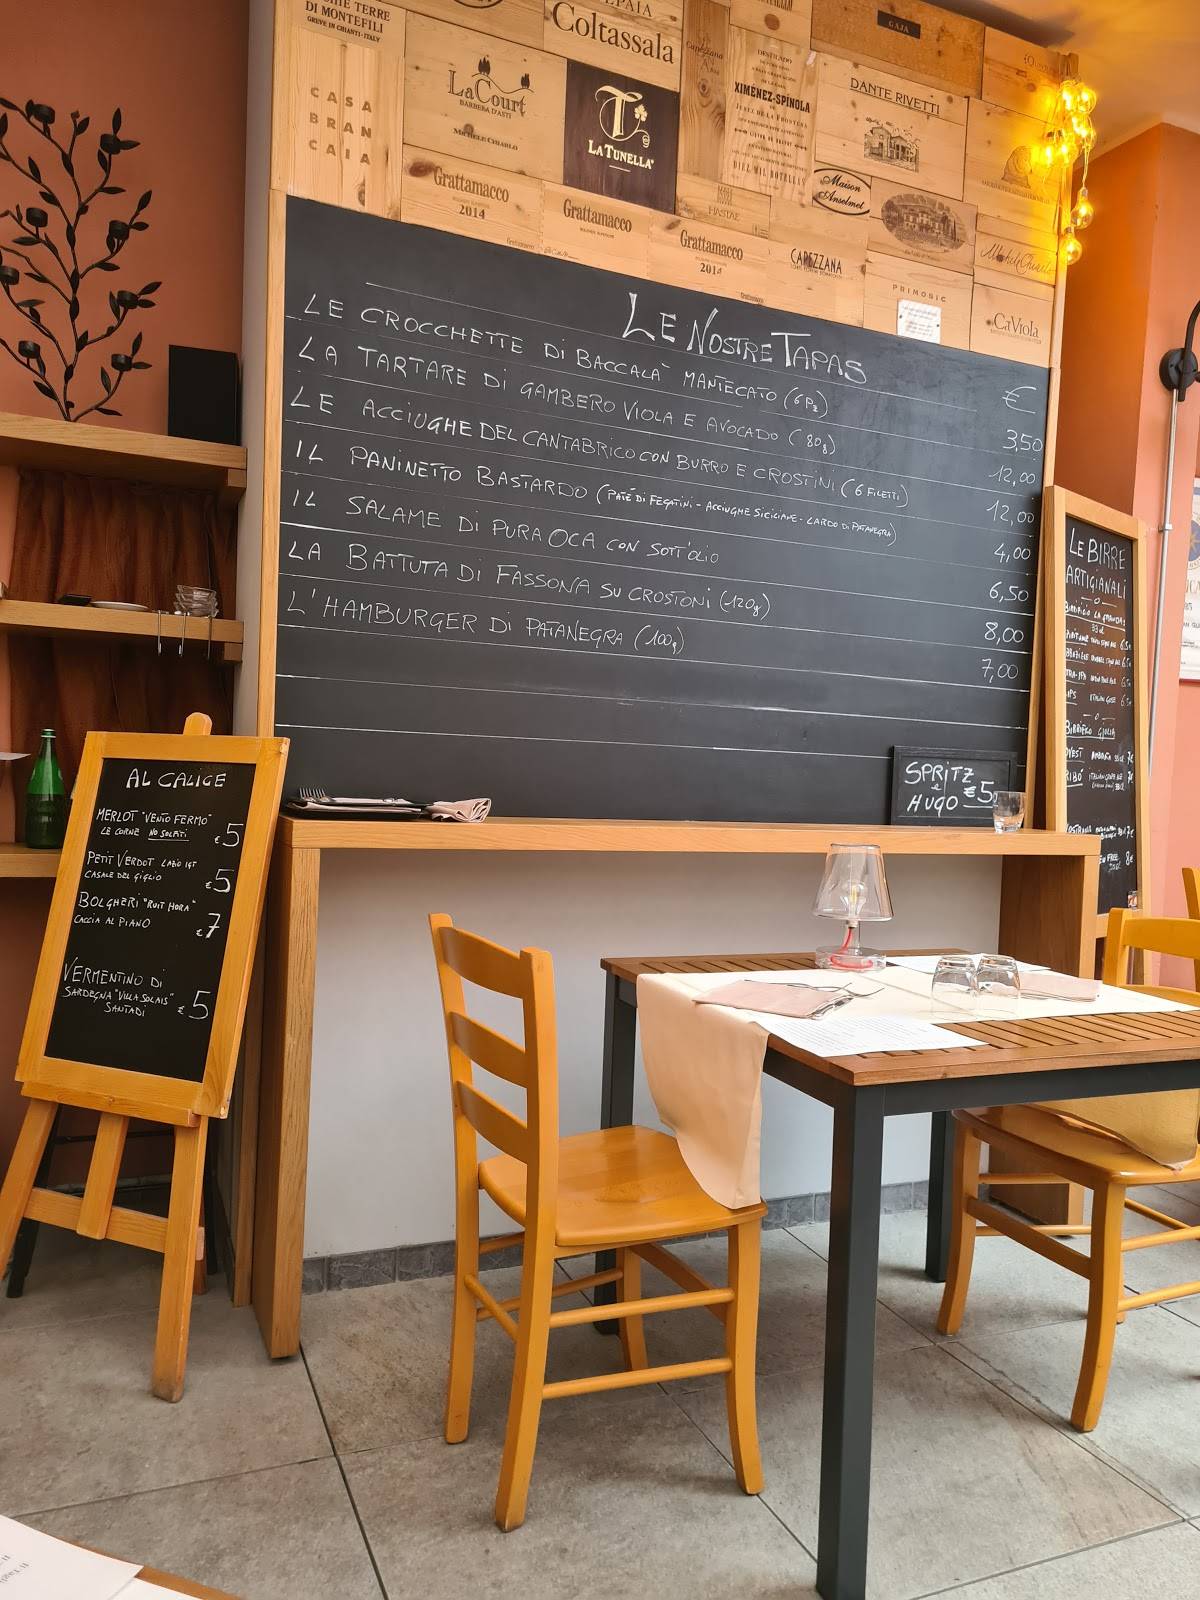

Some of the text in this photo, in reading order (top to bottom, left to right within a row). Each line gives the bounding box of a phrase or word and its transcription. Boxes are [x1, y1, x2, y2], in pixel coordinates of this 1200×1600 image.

[305, 0, 383, 33] DI MONTEFILI
[307, 15, 327, 27] GREVE
[355, 1, 391, 22] TERRE
[552, 1, 674, 64] Coltassala
[888, 20, 910, 34] GAJA
[850, 77, 940, 115] DANTE RIVETTI
[588, 139, 653, 170] LA TUNELLA
[433, 166, 510, 203] Grattamacco
[820, 174, 862, 194] Maison
[458, 204, 486, 220] 2014
[817, 190, 865, 211] Anselmet
[562, 198, 632, 233] Grattamacco
[679, 229, 744, 262] Grattamacco
[699, 262, 722, 276] 2014
[790, 247, 843, 275] CAPEZZANA
[304, 293, 344, 319] LE
[360, 307, 523, 355] CROCCHETTE
[682, 370, 777, 402] MANTECATO
[622, 291, 867, 385] LE NOSTRE TAPAS
[298, 336, 338, 366] LA
[357, 345, 467, 386] TARTARE
[520, 382, 616, 413] GAMBERO
[623, 400, 673, 425] VIOLA
[683, 413, 698, 428] E
[706, 416, 779, 441] AVOCADO
[290, 385, 334, 415] LE
[480, 422, 518, 443] DEL
[639, 451, 670, 463] CON
[676, 454, 730, 476] BURRO
[736, 463, 747, 479] E
[1002, 429, 1043, 453] 3,50
[296, 439, 324, 465] IL
[476, 465, 588, 500] BASTARDO
[806, 515, 839, 529] LARDO
[987, 464, 1036, 488] 12,00
[293, 488, 317, 508] IL
[345, 495, 442, 530] SALAME
[492, 519, 543, 542] PURA
[548, 528, 596, 550] OCA
[606, 537, 641, 553] CON
[986, 499, 1036, 528] 12,00
[993, 542, 1032, 564] 4,00
[1069, 527, 1126, 571] LE BIRRE
[288, 540, 321, 562] LA
[345, 543, 449, 578] BATTUTA
[496, 564, 590, 596] FASSONA
[599, 583, 622, 599] SU
[989, 581, 1030, 604] 6,50
[287, 587, 478, 635] L'HAMBURGER
[526, 616, 623, 649] PATANEGRA
[984, 621, 1025, 646] 8,00
[981, 658, 1019, 684] 7,00
[125, 767, 151, 789] AL
[95, 807, 139, 823] MERLOT
[907, 794, 959, 819] HUGO
[100, 827, 111, 836] LE
[114, 827, 140, 837] CORNE
[148, 827, 158, 837] NO
[117, 850, 155, 868] VERDOT
[84, 869, 114, 880] CASALE
[117, 872, 130, 880] DEL
[105, 916, 115, 926] AL
[118, 916, 151, 929] PIANO
[63, 956, 144, 986] VERMENTINO
[61, 985, 112, 1003] SARDEGNA
